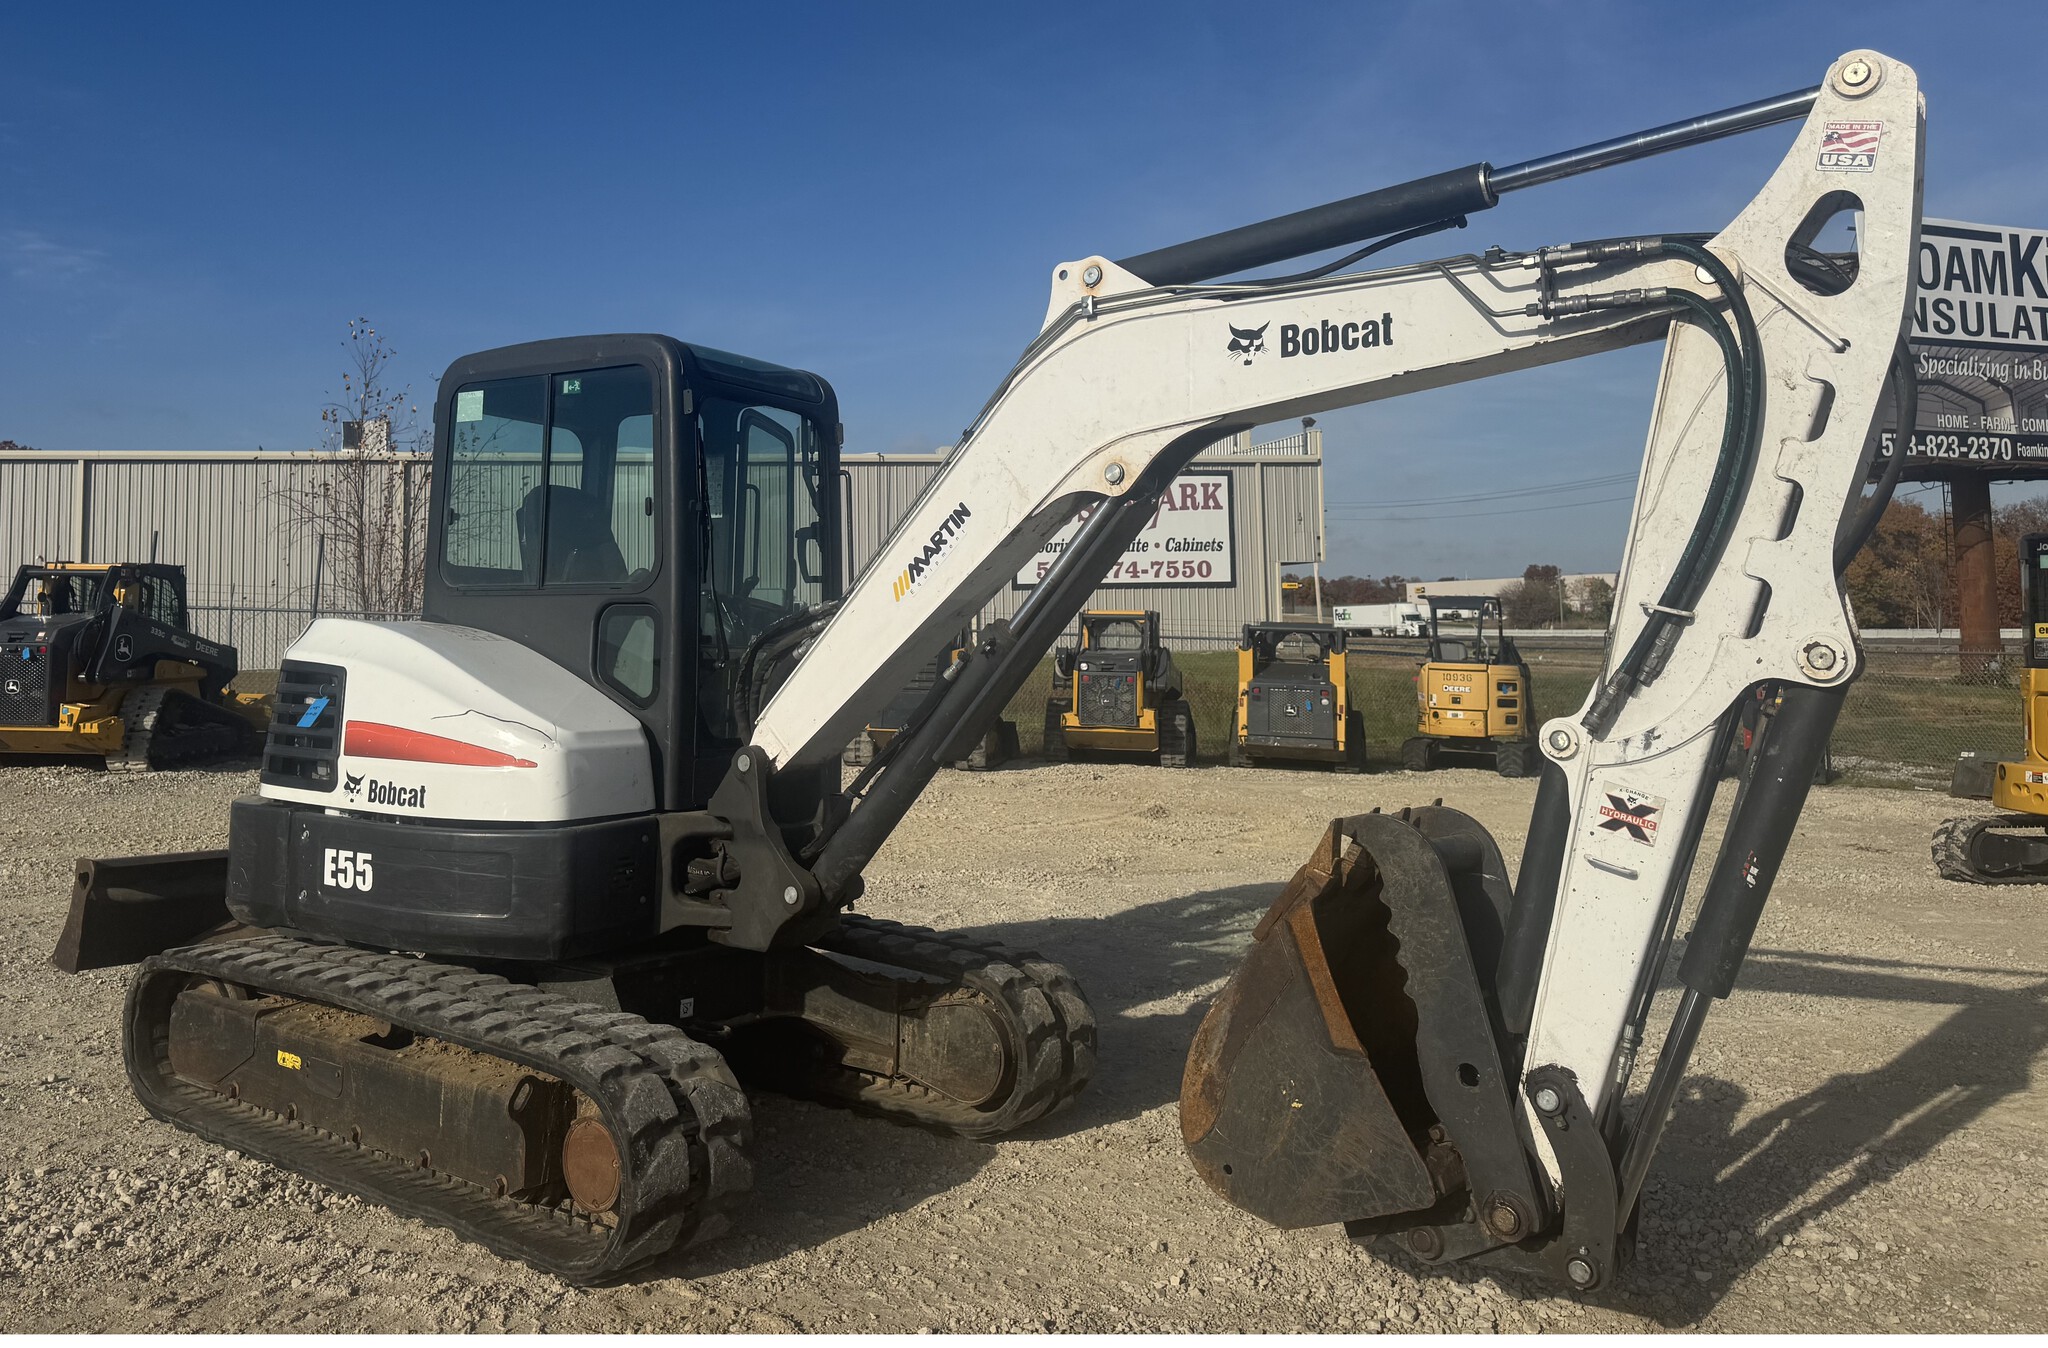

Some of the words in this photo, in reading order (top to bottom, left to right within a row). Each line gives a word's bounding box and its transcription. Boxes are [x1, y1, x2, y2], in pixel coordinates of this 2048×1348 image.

[1821, 154, 1869, 167] USA
[1281, 312, 1393, 358] Bobcat
[1919, 352, 2010, 383] Specializing
[2014, 358, 2028, 380] in
[1937, 414, 1969, 429] HOME
[1981, 416, 2011, 432] FARM
[908, 502, 971, 584] MARTIN
[1165, 537, 1223, 552] Cabinets
[1335, 608, 1352, 621] FedEx
[195, 640, 219, 656] DEERE
[1442, 684, 1471, 693] DEERE
[368, 779, 426, 808] Bobcat
[1601, 807, 1655, 830] HYDRAULIC
[323, 848, 373, 892] E55
